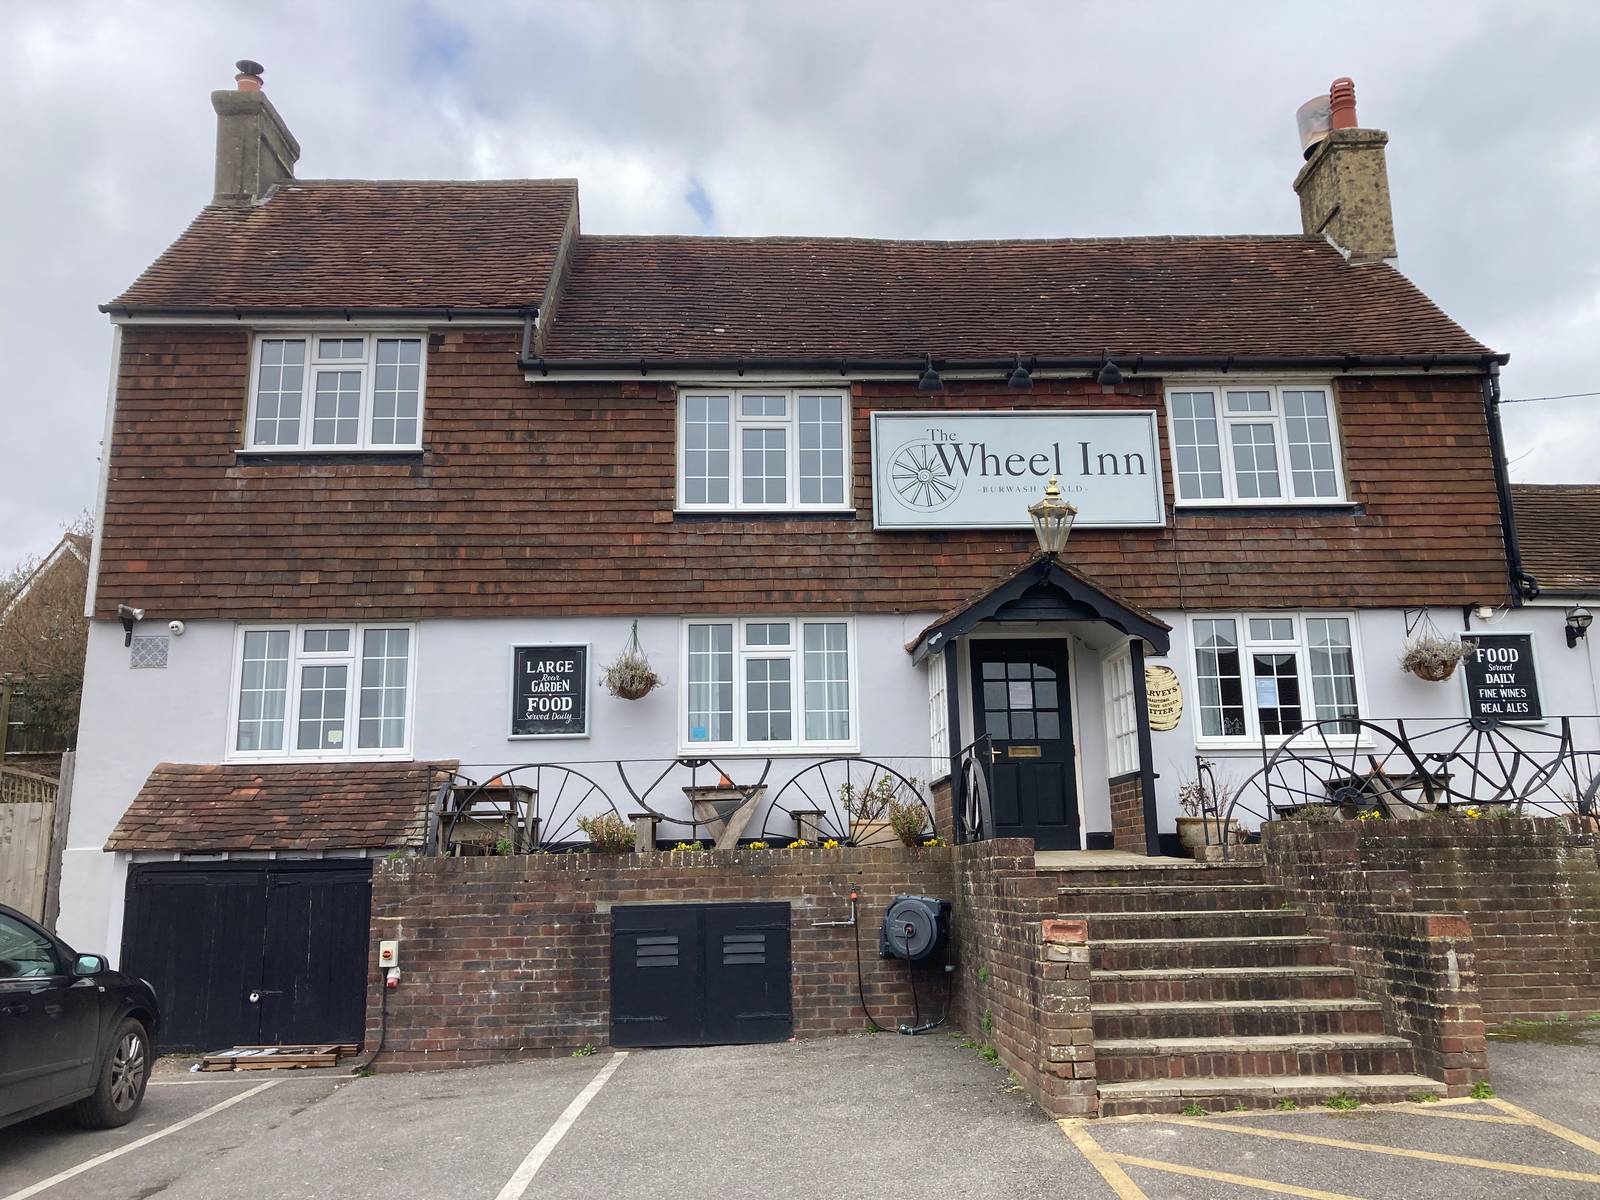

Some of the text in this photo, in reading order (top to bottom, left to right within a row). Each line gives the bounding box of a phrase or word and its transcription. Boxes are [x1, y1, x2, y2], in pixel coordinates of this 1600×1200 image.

[926, 428, 957, 442] The
[934, 441, 1147, 477] Wheel Inn
[1476, 648, 1519, 662] FOOD
[526, 660, 574, 673] LARGE
[1488, 663, 1513, 671] Served
[540, 673, 561, 682] Rear
[1485, 673, 1515, 684] DAILY
[531, 679, 570, 692] GARDEN
[1147, 686, 1178, 697] RVEY'S
[1479, 688, 1527, 698] FINE WINES
[527, 697, 573, 711] FOOD
[1481, 702, 1529, 713] REAL ALES
[525, 711, 573, 724] Served Daily
